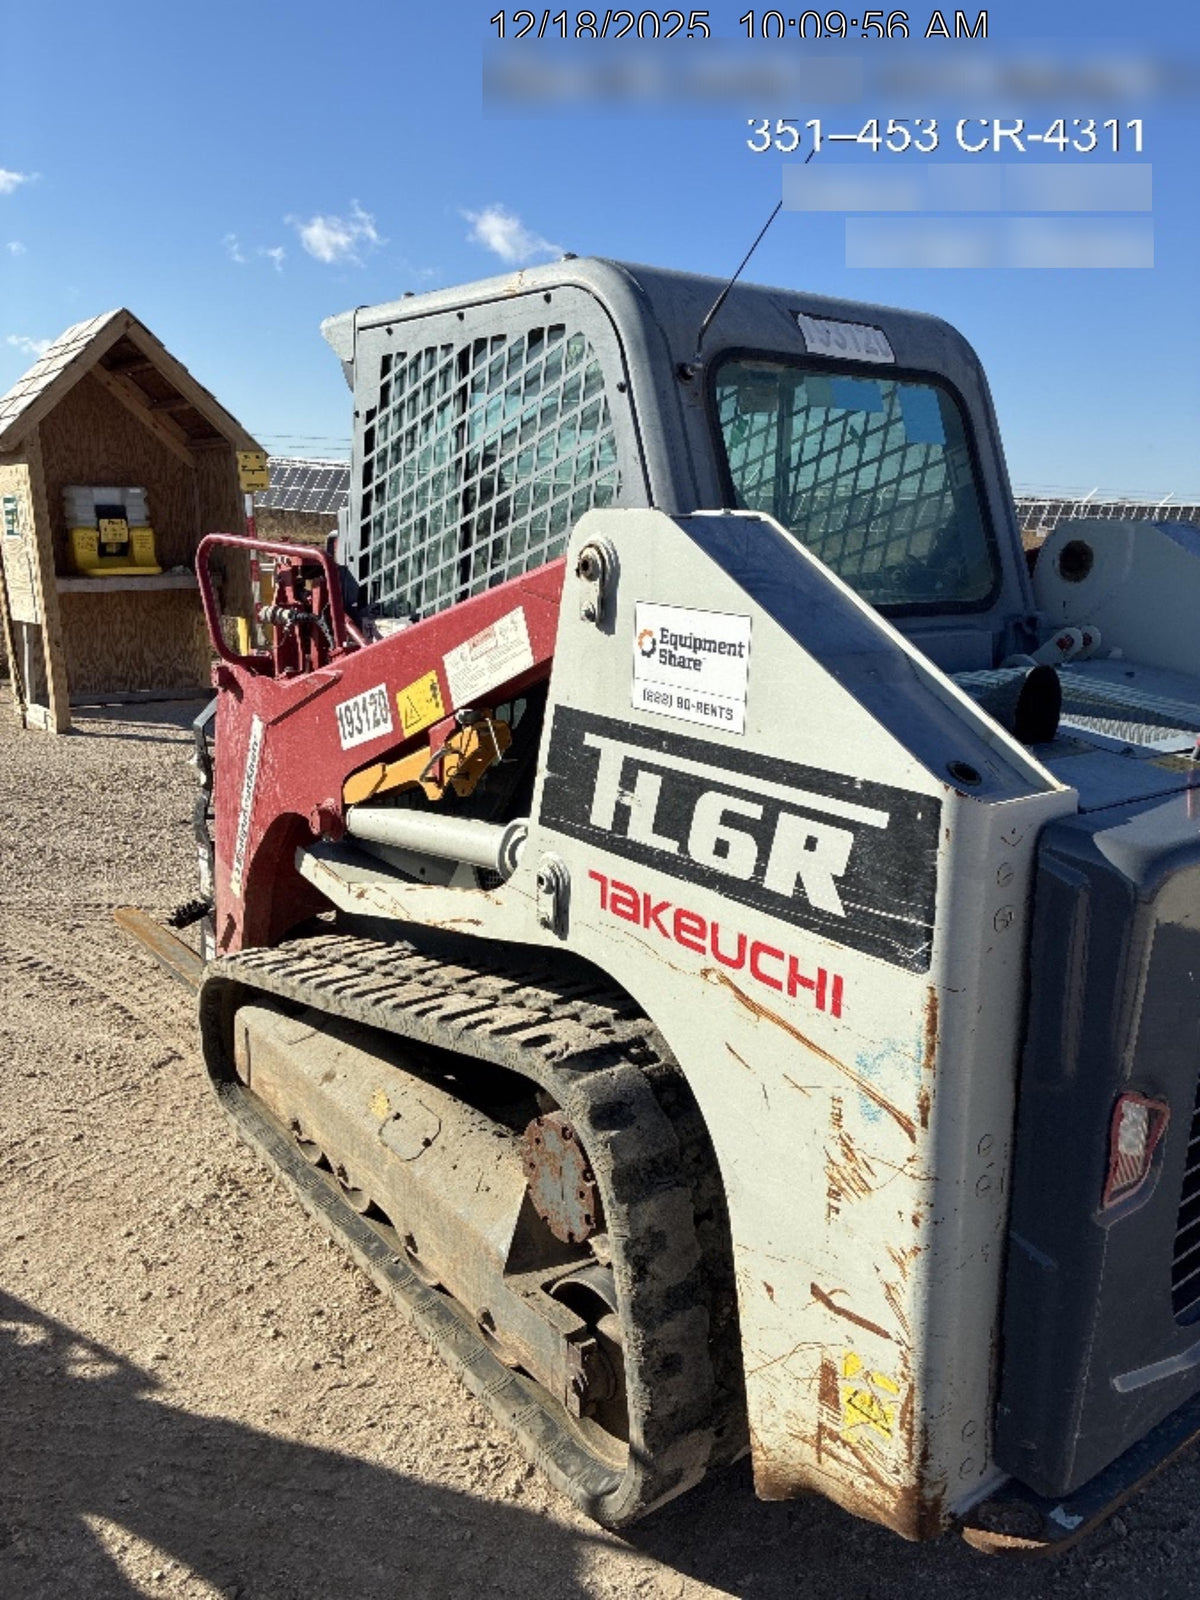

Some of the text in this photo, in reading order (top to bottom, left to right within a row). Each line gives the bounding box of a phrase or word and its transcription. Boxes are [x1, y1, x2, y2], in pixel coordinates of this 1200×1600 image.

[659, 627, 745, 658] Equipment
[659, 648, 702, 671] Share
[337, 688, 391, 741] 193120
[583, 732, 890, 919] TL6R
